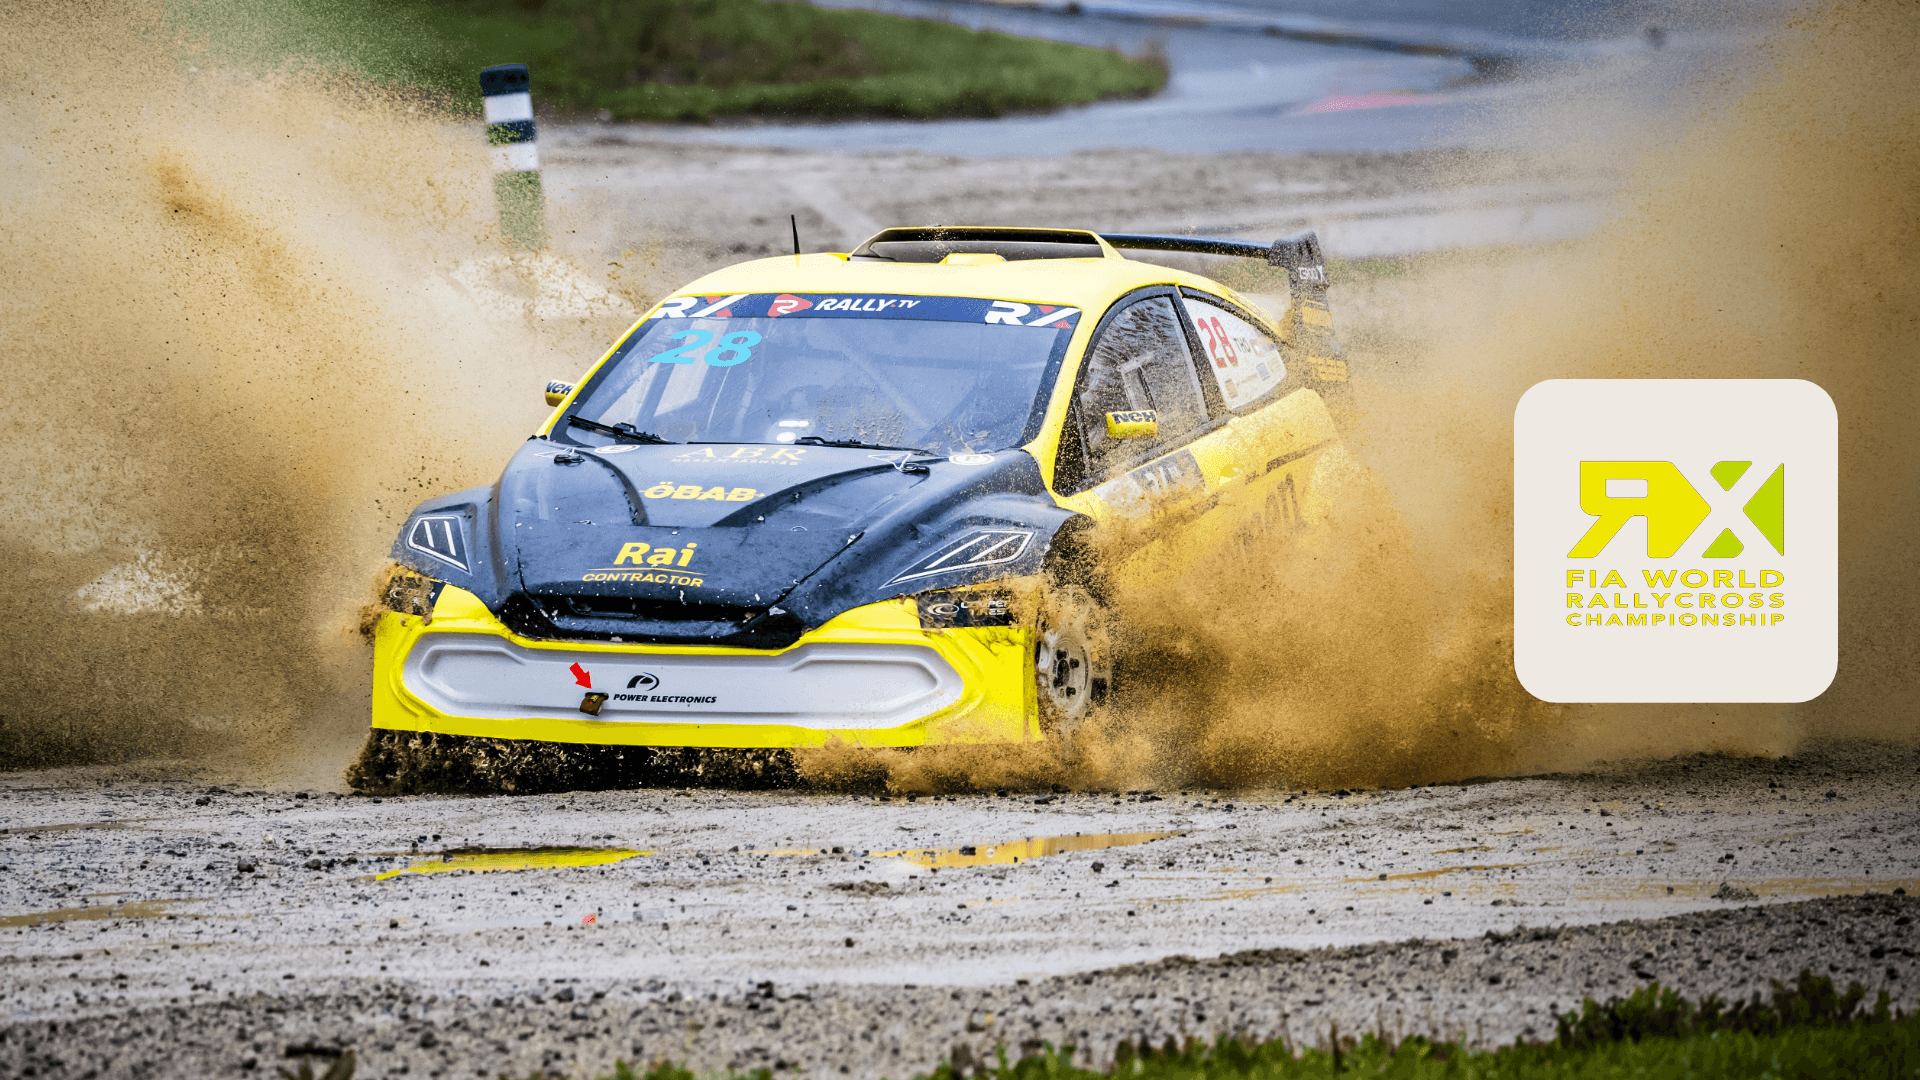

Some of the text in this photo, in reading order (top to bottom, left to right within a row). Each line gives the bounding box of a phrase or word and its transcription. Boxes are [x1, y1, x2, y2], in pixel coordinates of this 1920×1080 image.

[647, 329, 762, 367] 28
[1197, 316, 1239, 368] 28
[676, 447, 807, 461] ABR
[643, 481, 757, 502] ÖBAB
[613, 542, 698, 567] Rai
[582, 573, 704, 588] CONTRACTOR
[613, 693, 717, 704] POWER ELECTRONICS
